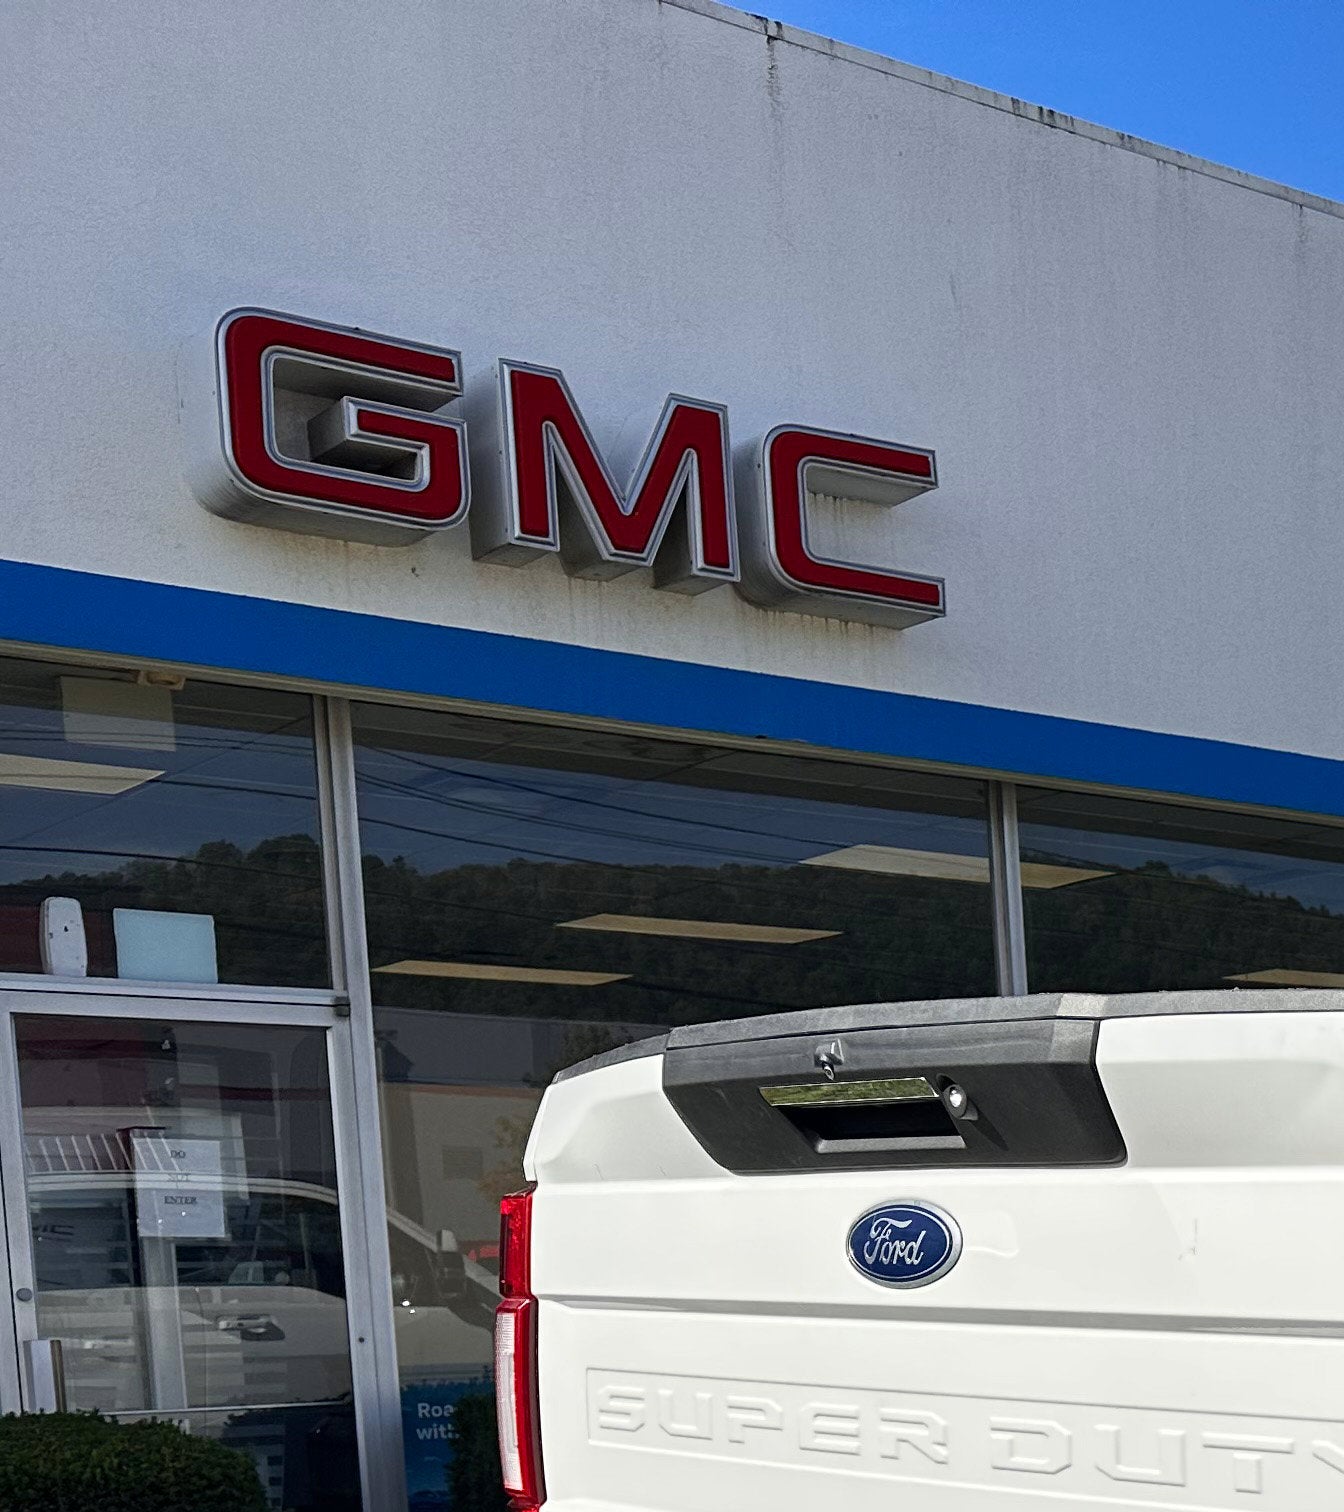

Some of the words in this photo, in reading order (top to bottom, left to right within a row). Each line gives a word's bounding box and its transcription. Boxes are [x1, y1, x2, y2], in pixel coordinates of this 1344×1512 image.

[211, 306, 946, 624] GMC
[170, 1150, 186, 1159] DO
[164, 1195, 197, 1205] ENTER
[862, 1217, 927, 1265] Ford
[597, 1385, 949, 1465] SUPER
